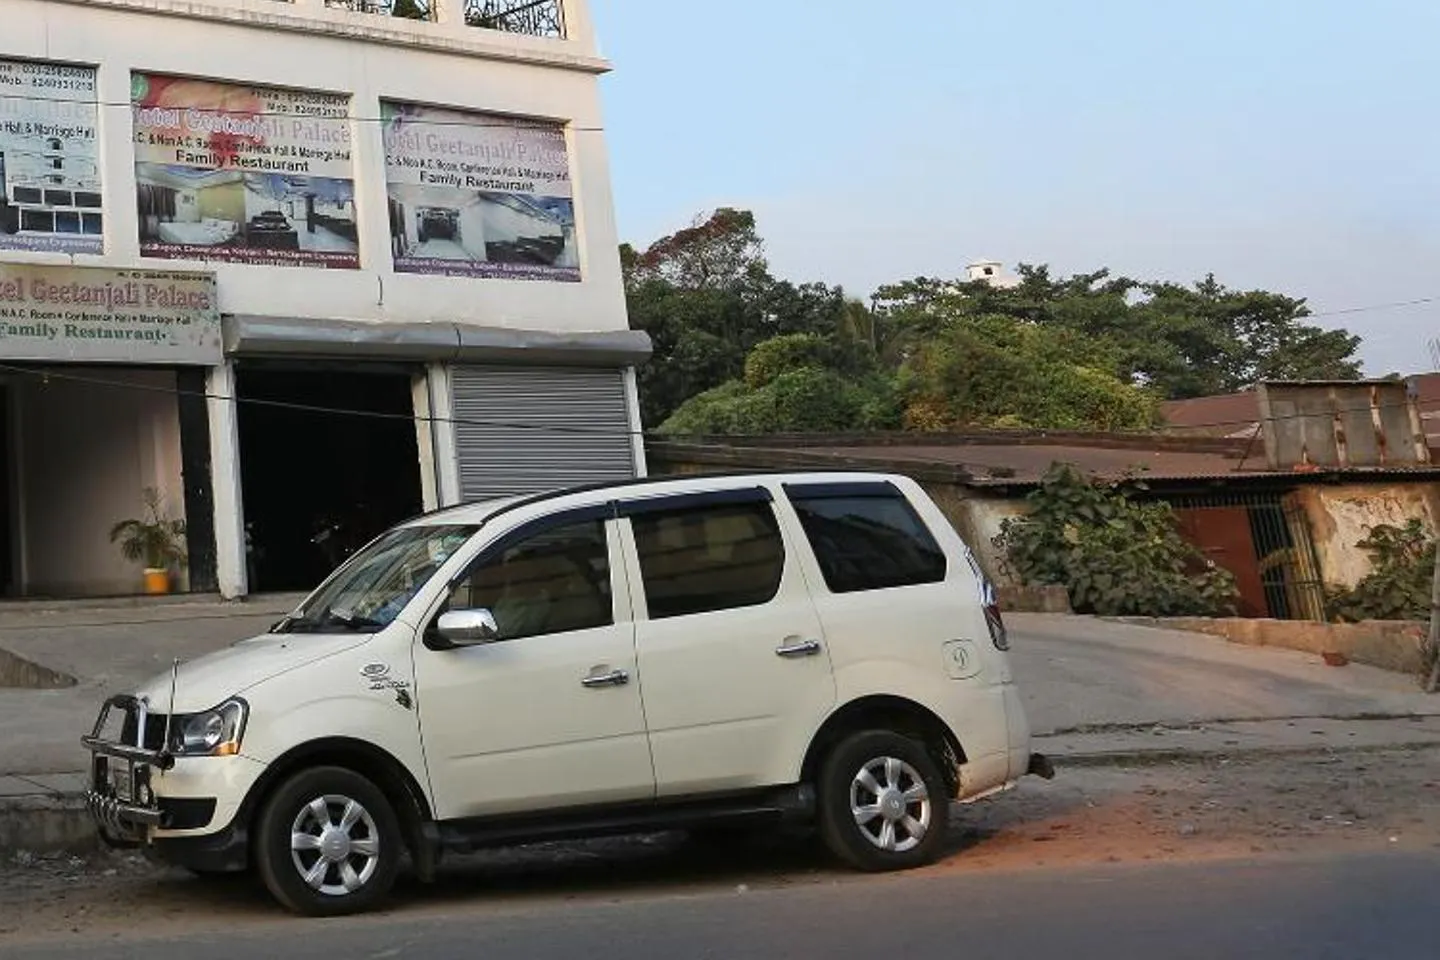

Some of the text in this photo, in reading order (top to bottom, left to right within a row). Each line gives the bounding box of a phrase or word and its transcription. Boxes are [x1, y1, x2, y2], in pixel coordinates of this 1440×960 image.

[187, 107, 284, 141] Geetanjali
[292, 120, 350, 143] Palace
[176, 149, 309, 172] Family Restaurant
[426, 134, 508, 162] Geetanjali
[420, 171, 535, 192] Family Restaurant
[33, 278, 138, 311] Geetanjali
[144, 283, 211, 310] Palace
[65, 324, 162, 342] Restaurant
